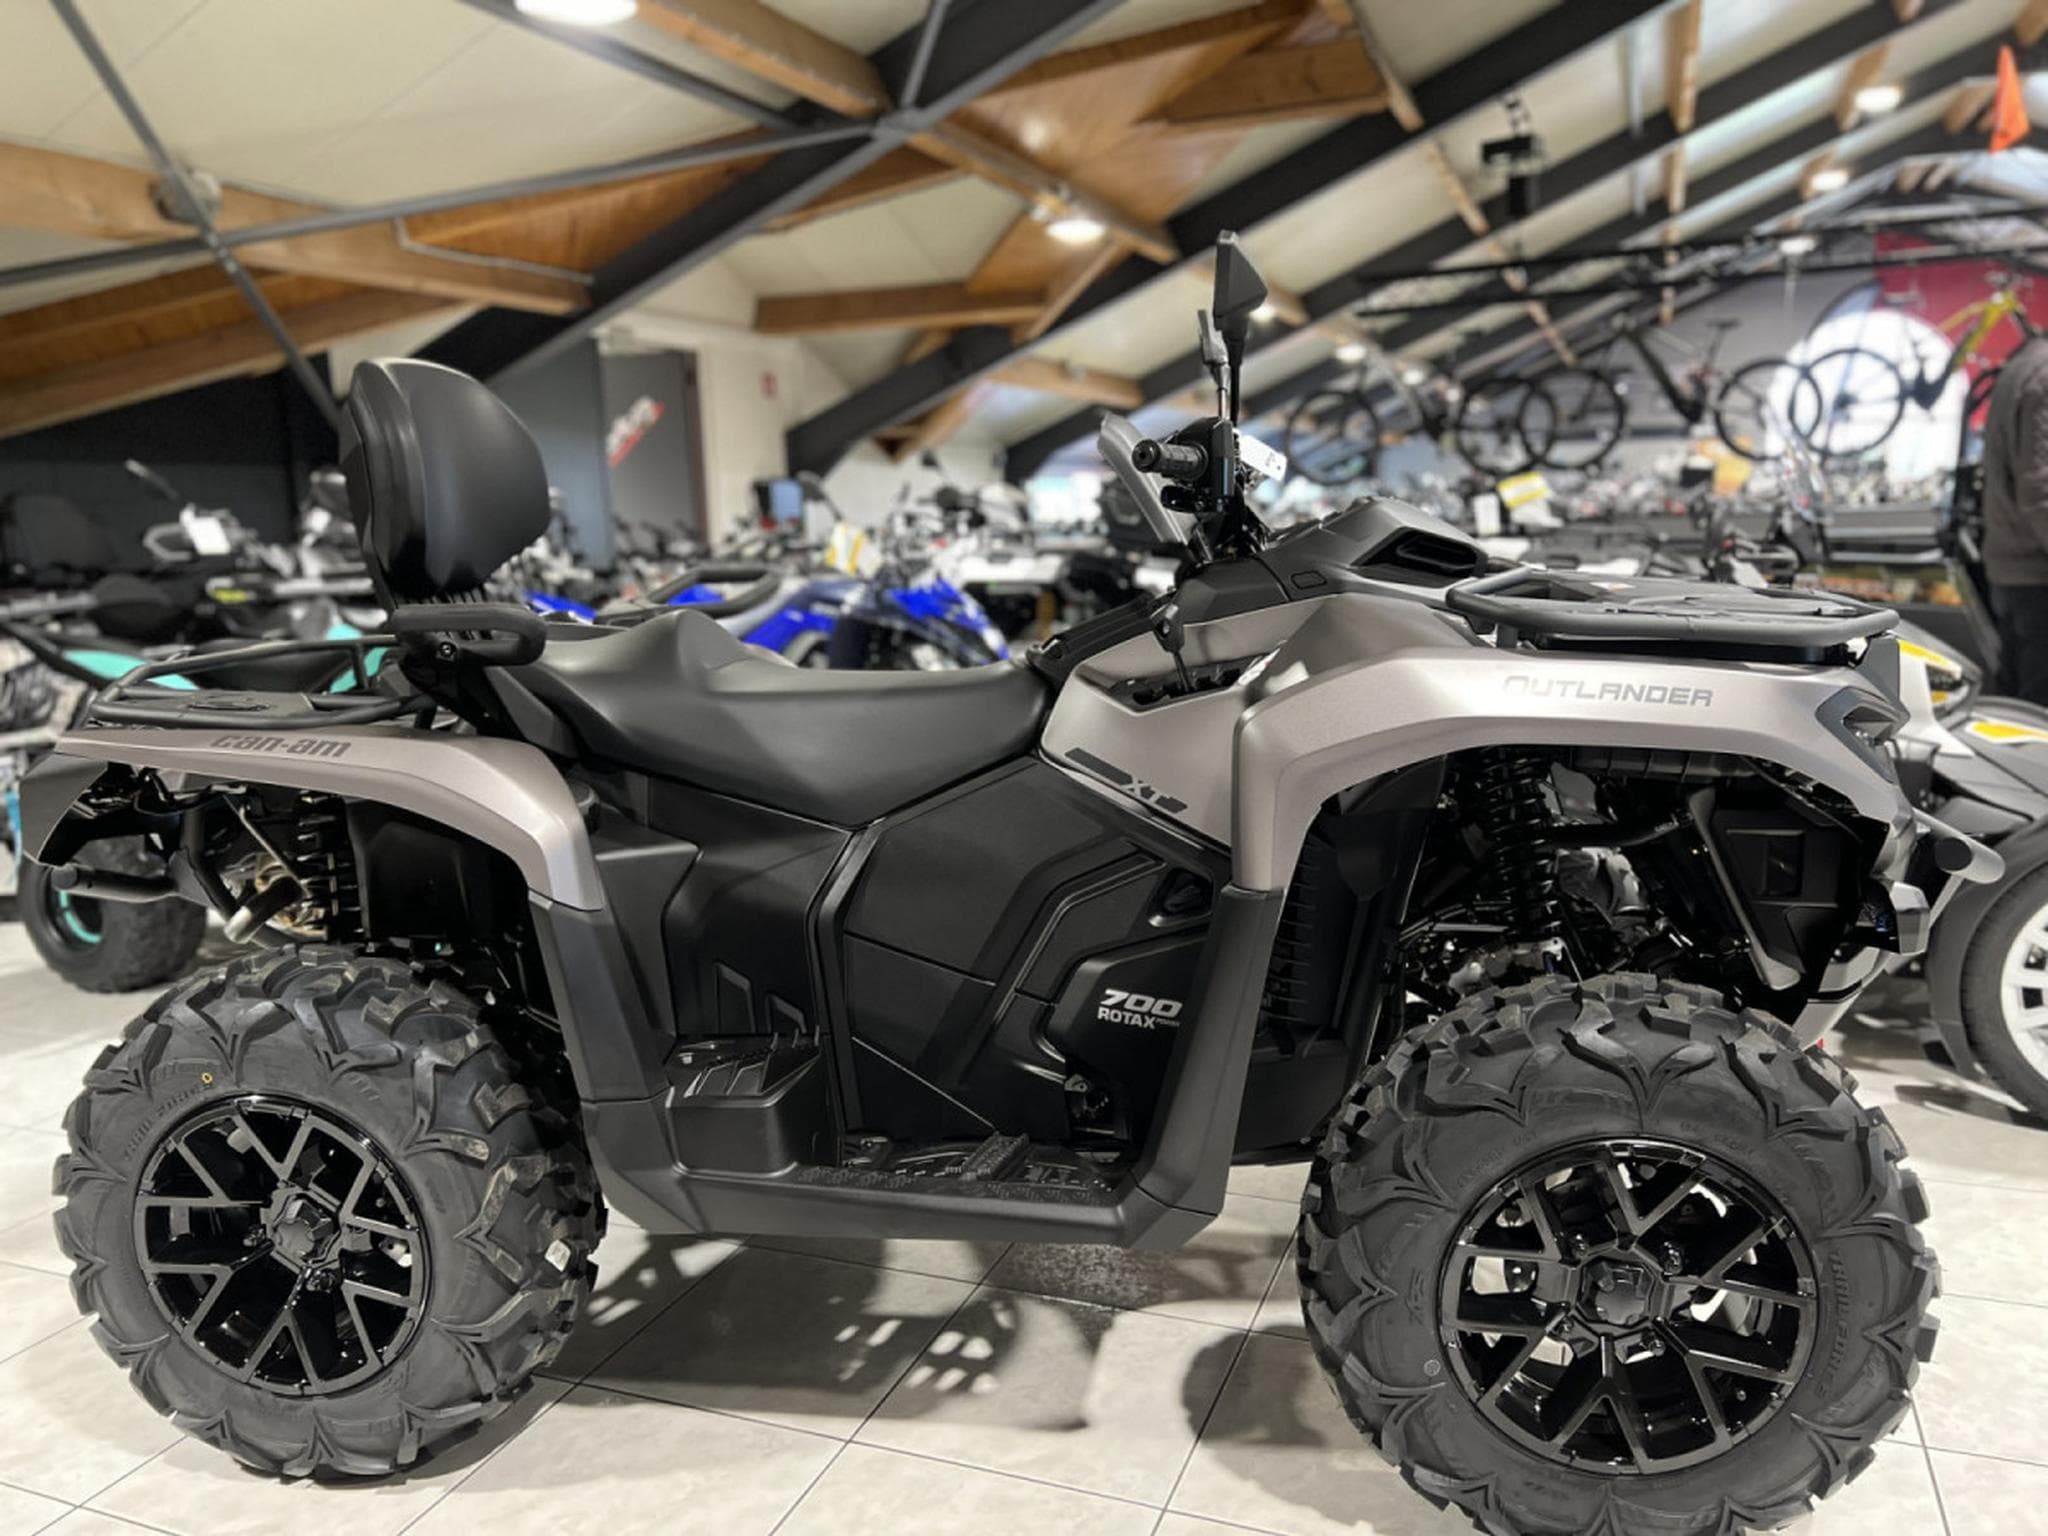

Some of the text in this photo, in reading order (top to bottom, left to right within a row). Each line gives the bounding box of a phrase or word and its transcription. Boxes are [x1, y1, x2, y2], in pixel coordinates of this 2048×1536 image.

[1503, 675, 1714, 707] OUTLANDER
[1097, 1005, 1156, 1030] ROTAX
[1100, 987, 1183, 1018] 700
